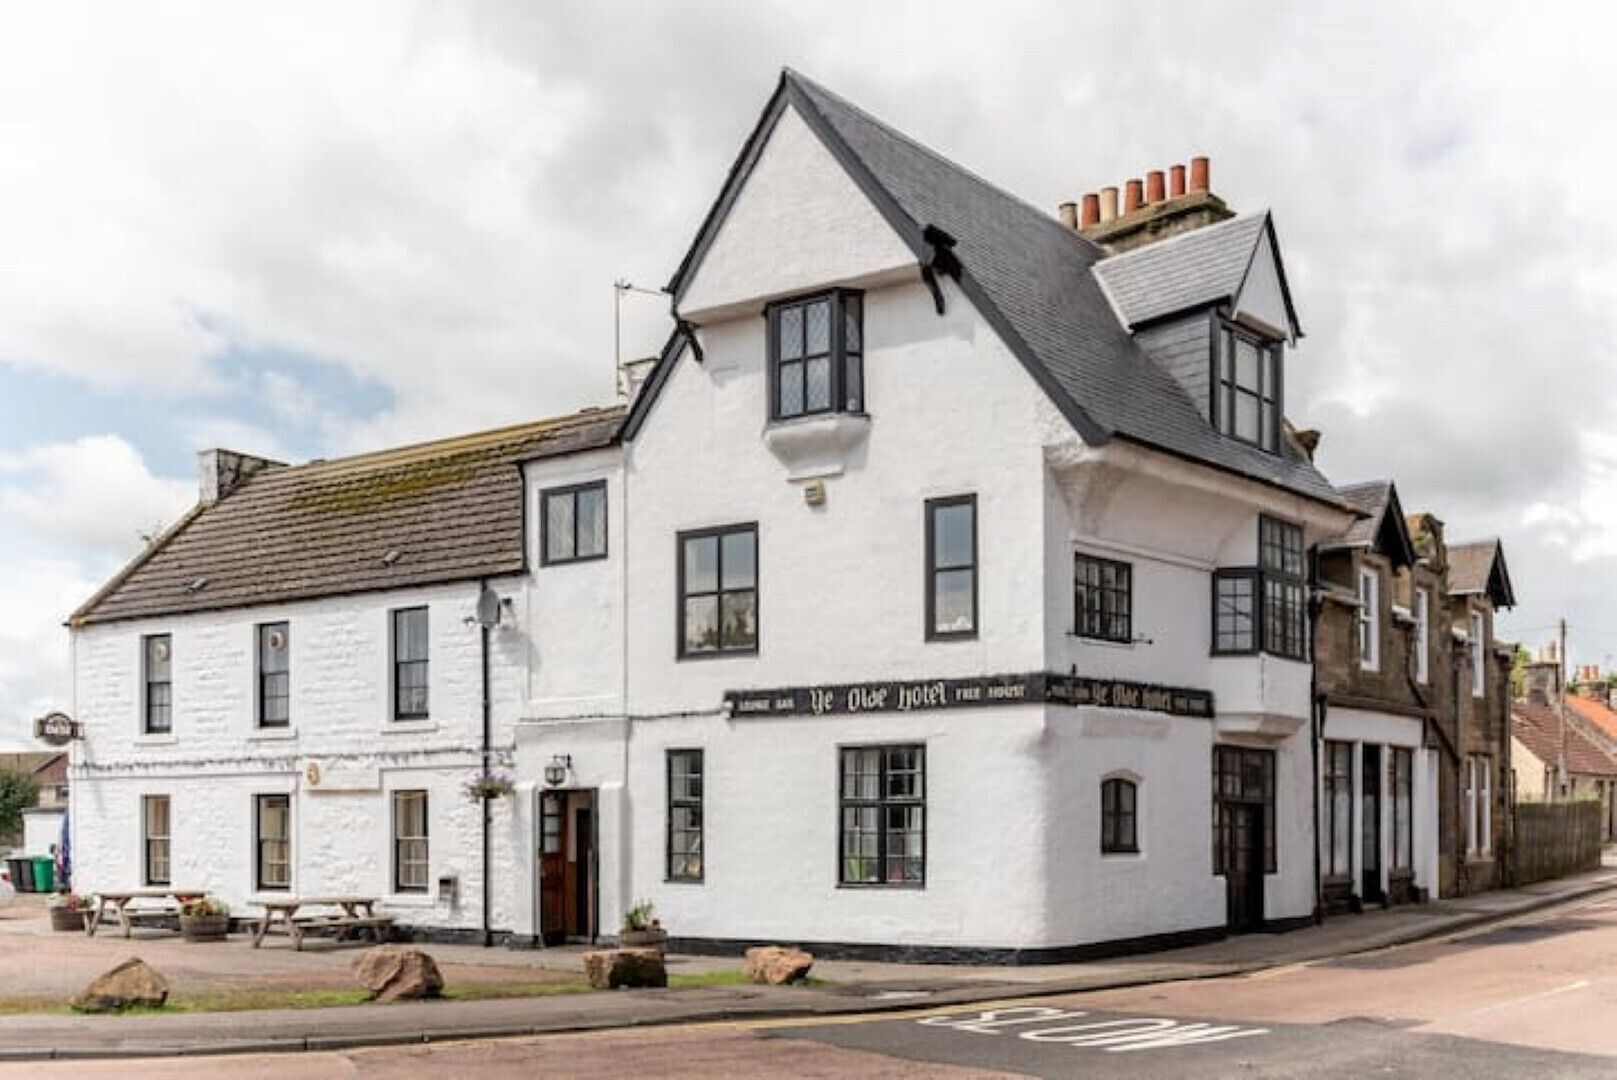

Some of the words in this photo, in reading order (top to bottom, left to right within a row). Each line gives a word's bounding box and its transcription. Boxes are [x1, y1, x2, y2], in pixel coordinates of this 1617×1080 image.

[810, 688, 834, 716] Ye
[847, 687, 888, 712] Olde
[897, 681, 947, 710] Hotel
